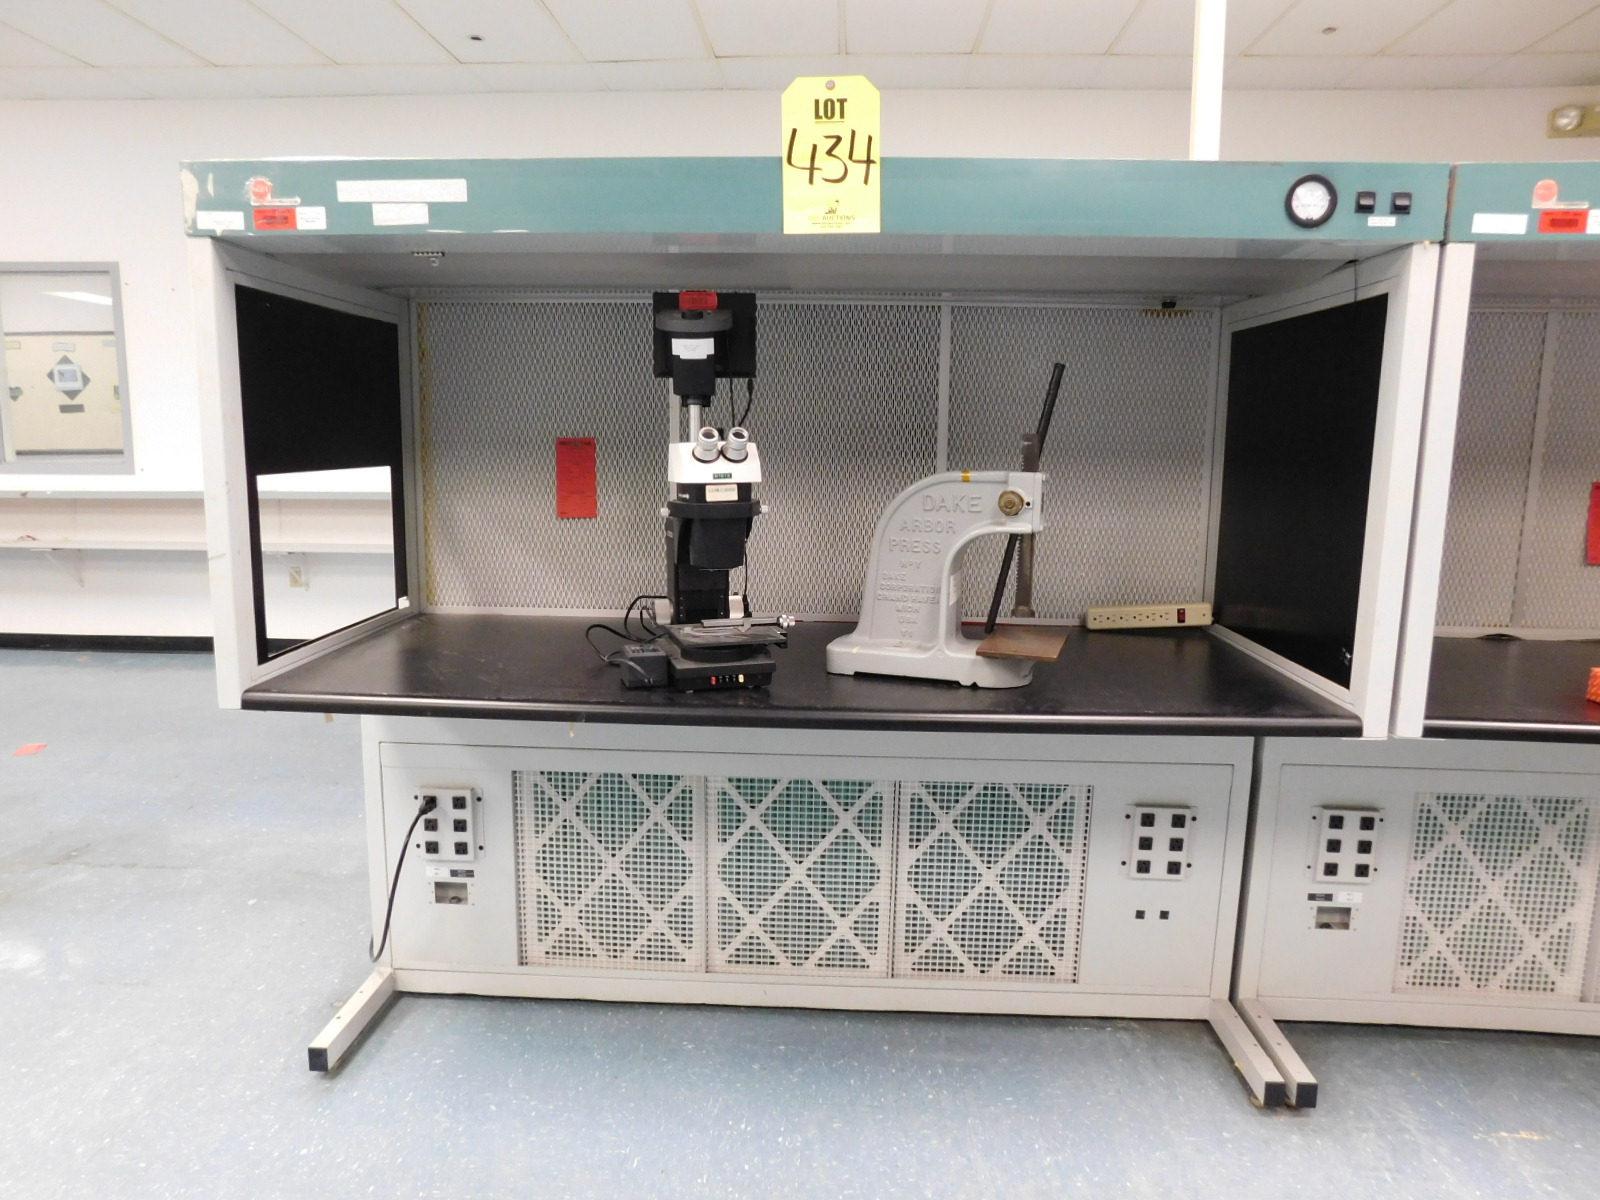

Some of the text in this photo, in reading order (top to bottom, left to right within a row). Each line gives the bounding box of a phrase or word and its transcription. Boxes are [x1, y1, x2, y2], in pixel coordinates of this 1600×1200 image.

[814, 98, 847, 120] LOT
[786, 128, 877, 186] 434
[822, 214, 856, 222] AUCTIONS
[922, 494, 983, 513] DAKE
[900, 519, 956, 535] ARBOR
[888, 537, 942, 554] PRESS
[881, 571, 907, 581] DAKE
[877, 591, 909, 603] GRAND
[897, 614, 918, 625] USA
